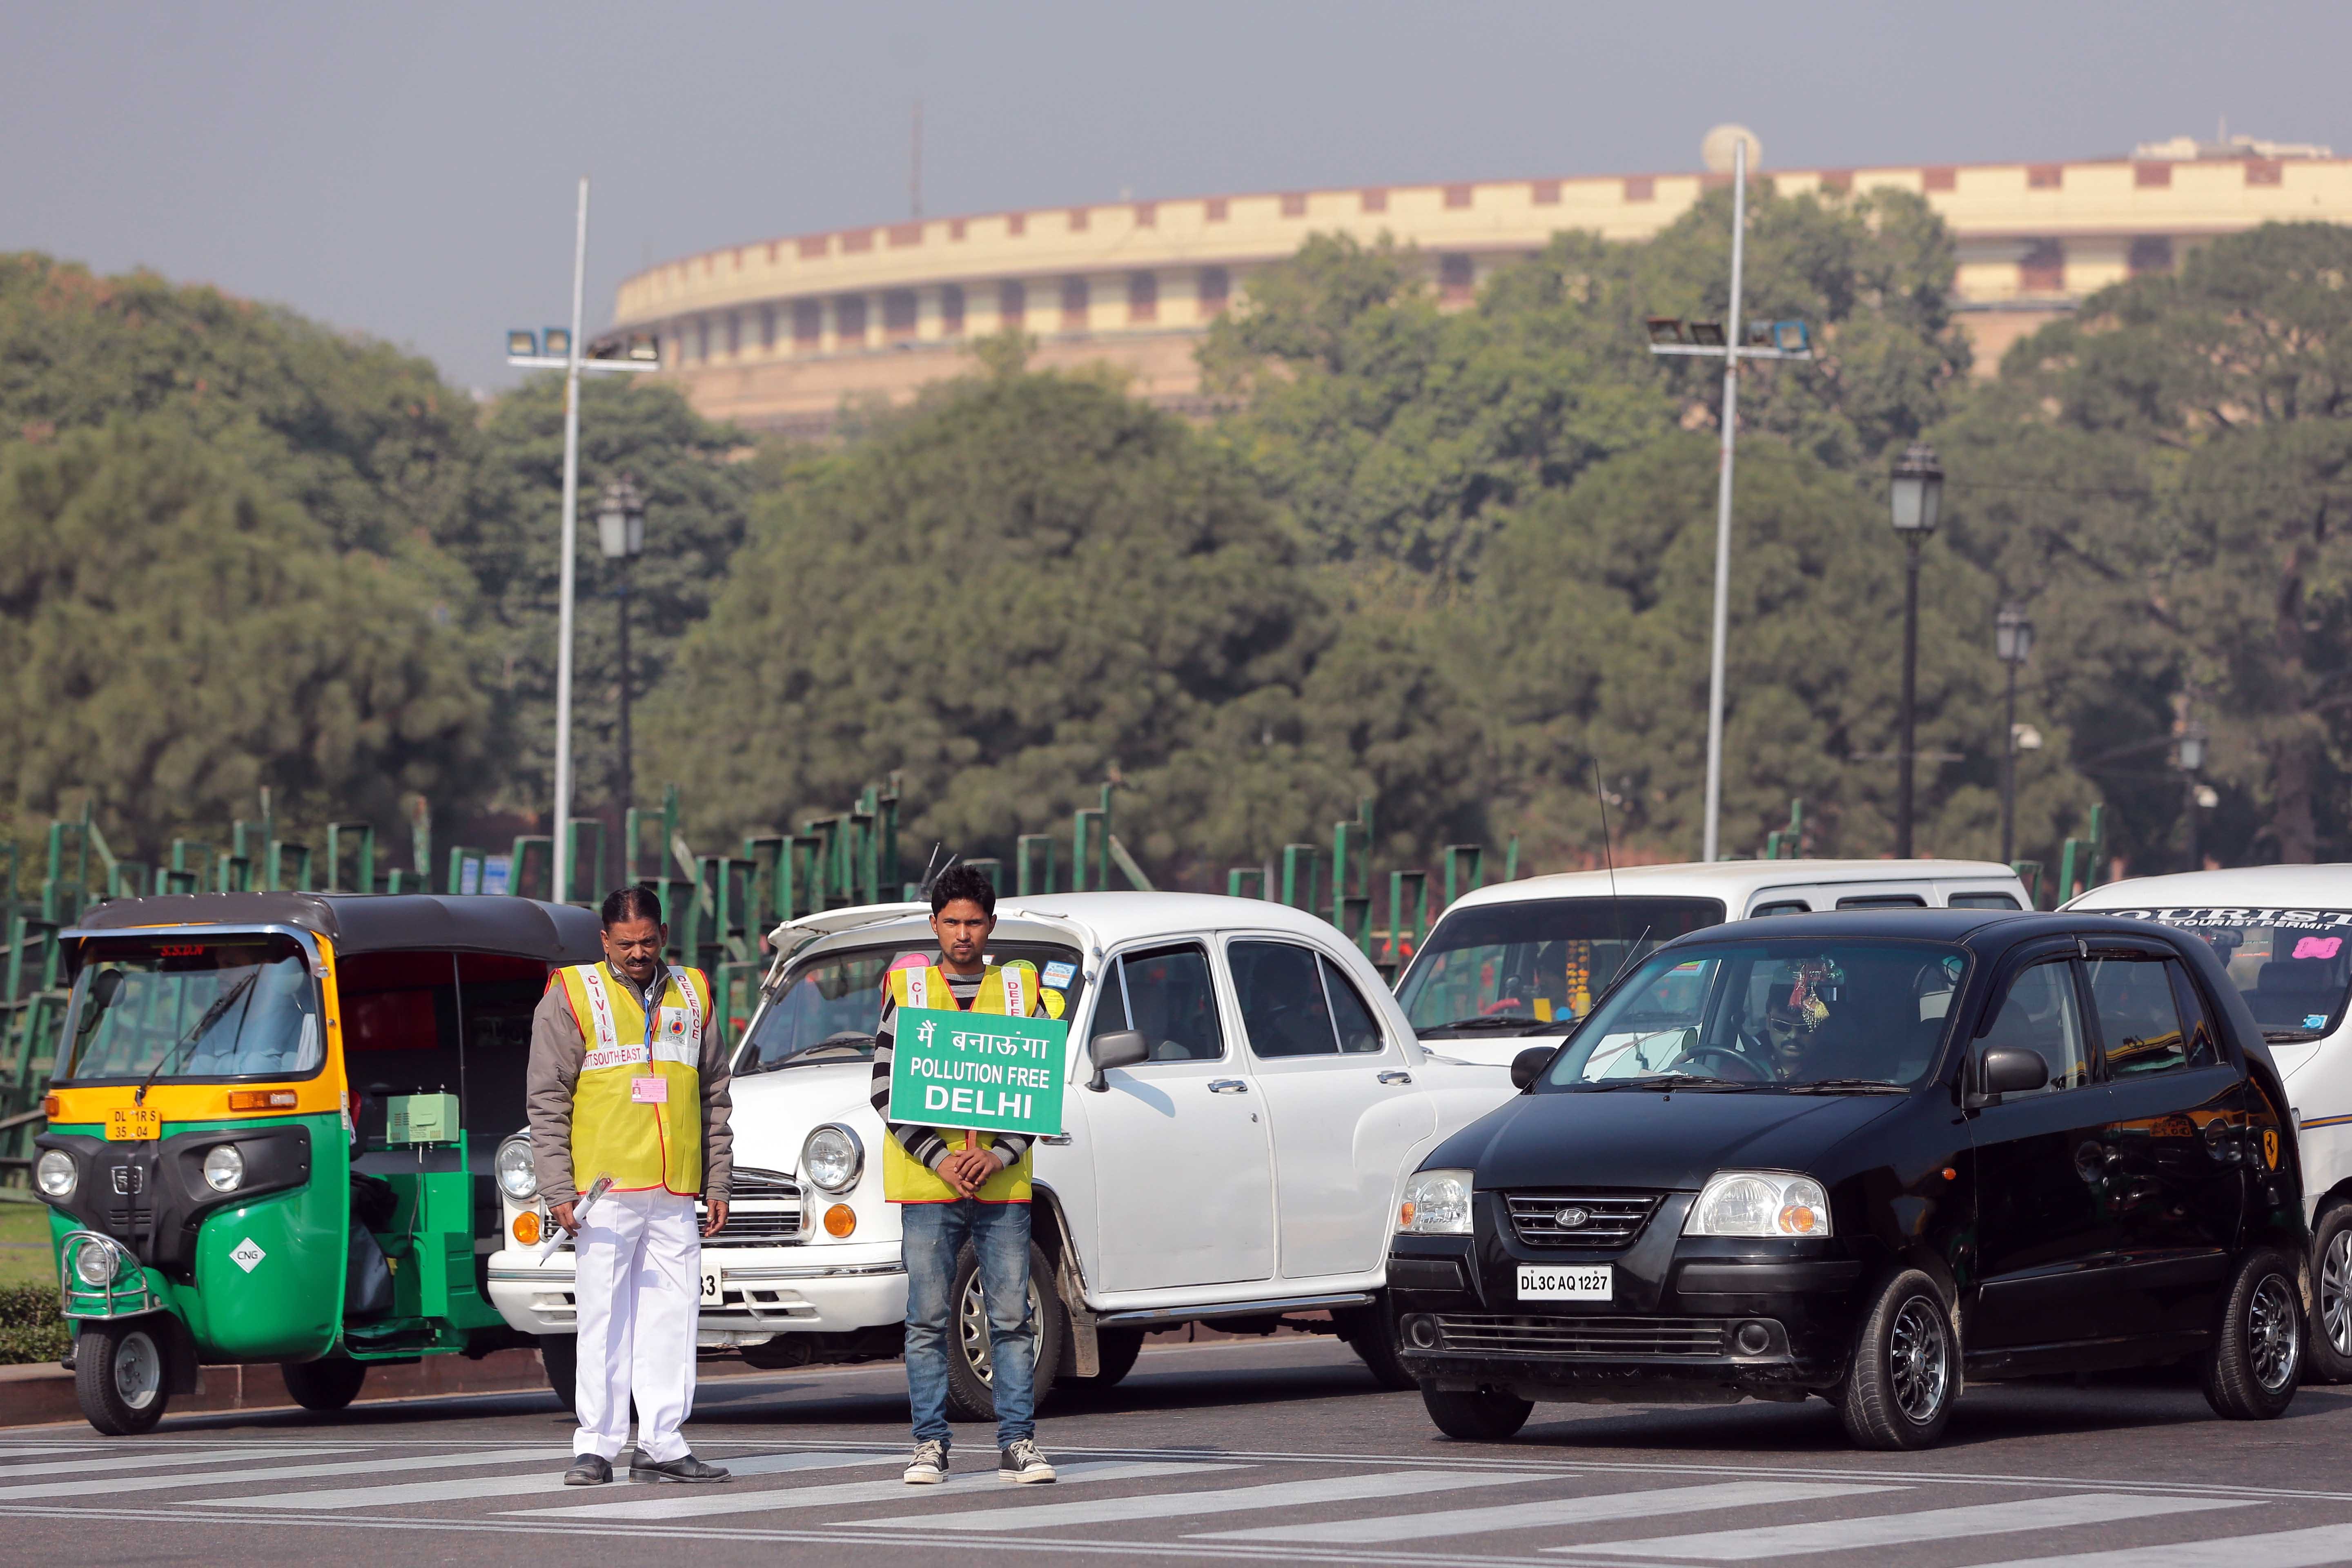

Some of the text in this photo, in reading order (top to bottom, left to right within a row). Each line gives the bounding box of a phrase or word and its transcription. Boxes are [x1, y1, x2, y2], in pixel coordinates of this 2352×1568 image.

[2100, 909, 2352, 925] OURIST
[2260, 920, 2335, 931] PERMIT
[588, 976, 612, 1042] CIVIL
[676, 975, 700, 1040] DEFENCE
[916, 1020, 937, 1048] मैं
[911, 1057, 1050, 1089] POLLUTION FREE
[924, 1085, 1032, 1119] DELHI
[115, 1111, 126, 1122] DL
[116, 1127, 126, 1137] 35
[237, 1250, 258, 1260] CNG
[1521, 1276, 1608, 1291] DL3C AQ 1227
